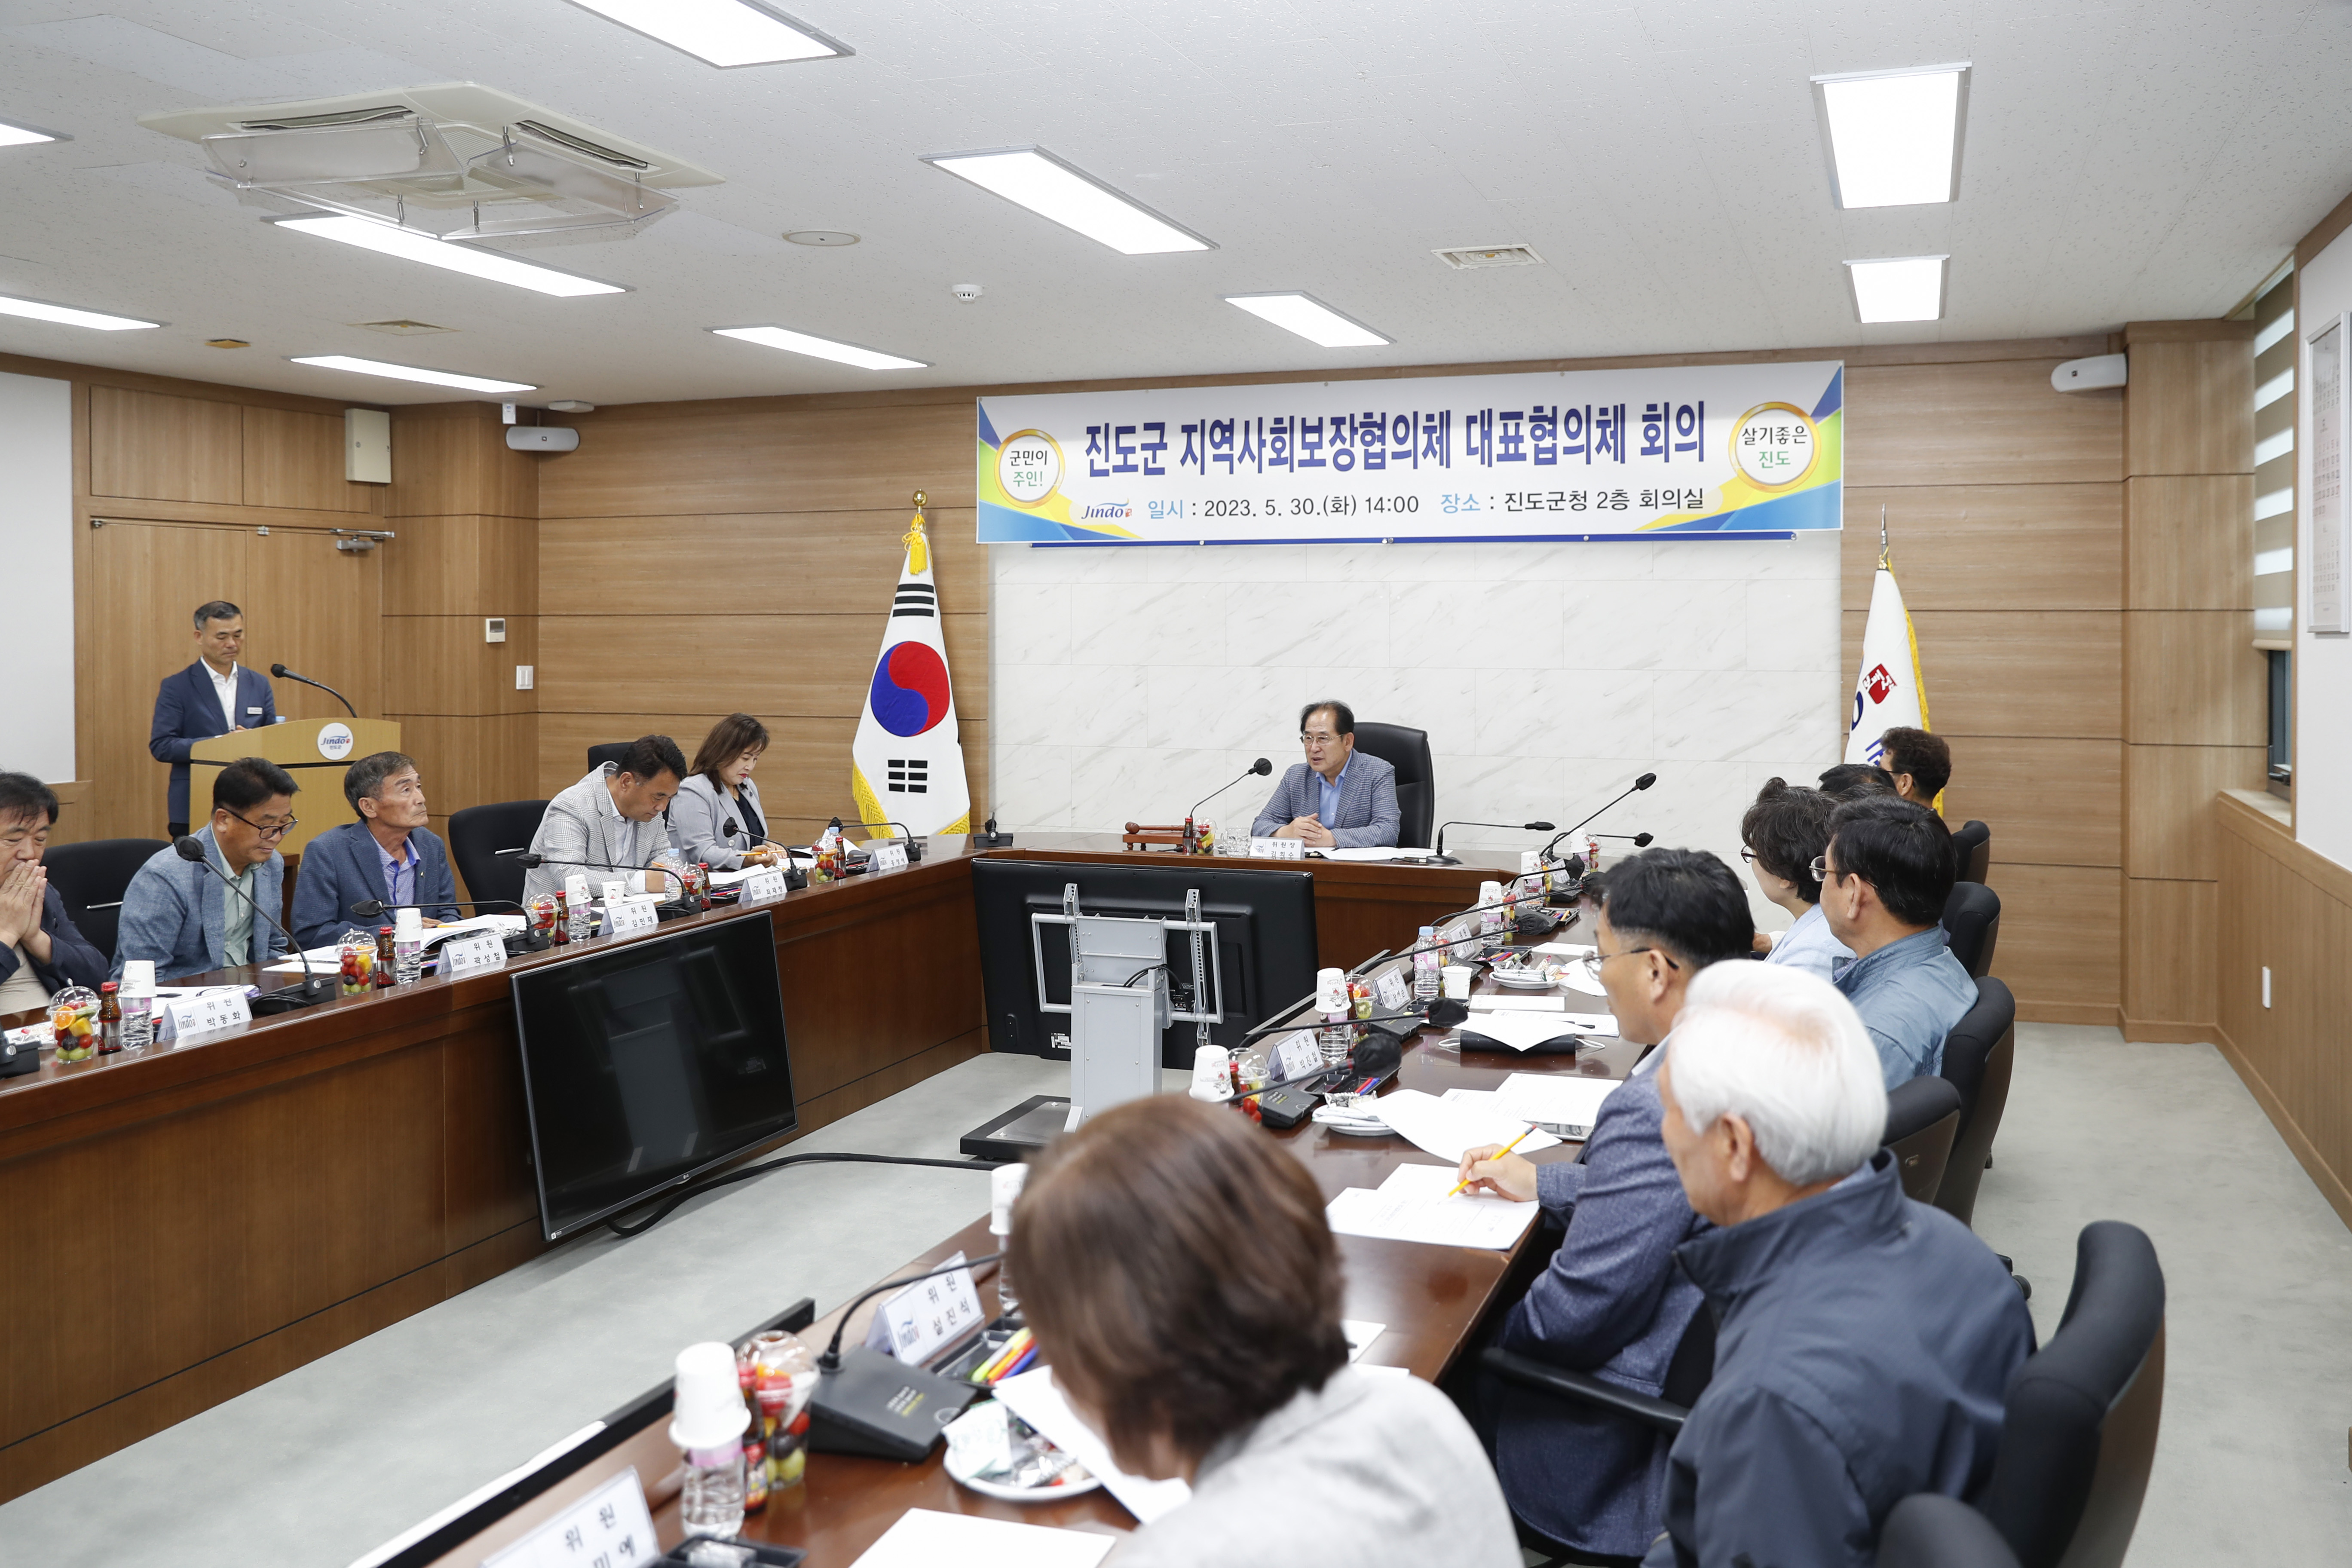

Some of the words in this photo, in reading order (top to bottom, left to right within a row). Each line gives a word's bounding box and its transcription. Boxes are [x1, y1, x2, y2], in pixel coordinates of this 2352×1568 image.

[1085, 421, 1168, 478] 진도군
[1179, 409, 1451, 476] 지역사회보장협의체
[1465, 403, 1626, 468] 대표협의체
[1640, 400, 1705, 463] 회의
[1741, 425, 1808, 445] 살기좋은
[1009, 450, 1047, 466] 군민이
[1758, 451, 1791, 469] 진도
[1013, 471, 1043, 487] 주인!
[1148, 499, 1183, 520] 일시
[1204, 499, 1256, 517] 2023.
[1265, 499, 1282, 517] 5.
[1290, 494, 1357, 517] 30.(화)
[1365, 495, 1419, 514] 14:00
[1440, 493, 1481, 514] 장소
[1504, 490, 1587, 512] 진도군청
[1596, 489, 1630, 511] 2층
[1639, 488, 1703, 510] 회의실
[474, 952, 501, 965] 곽성철
[206, 1011, 241, 1027] 박동화
